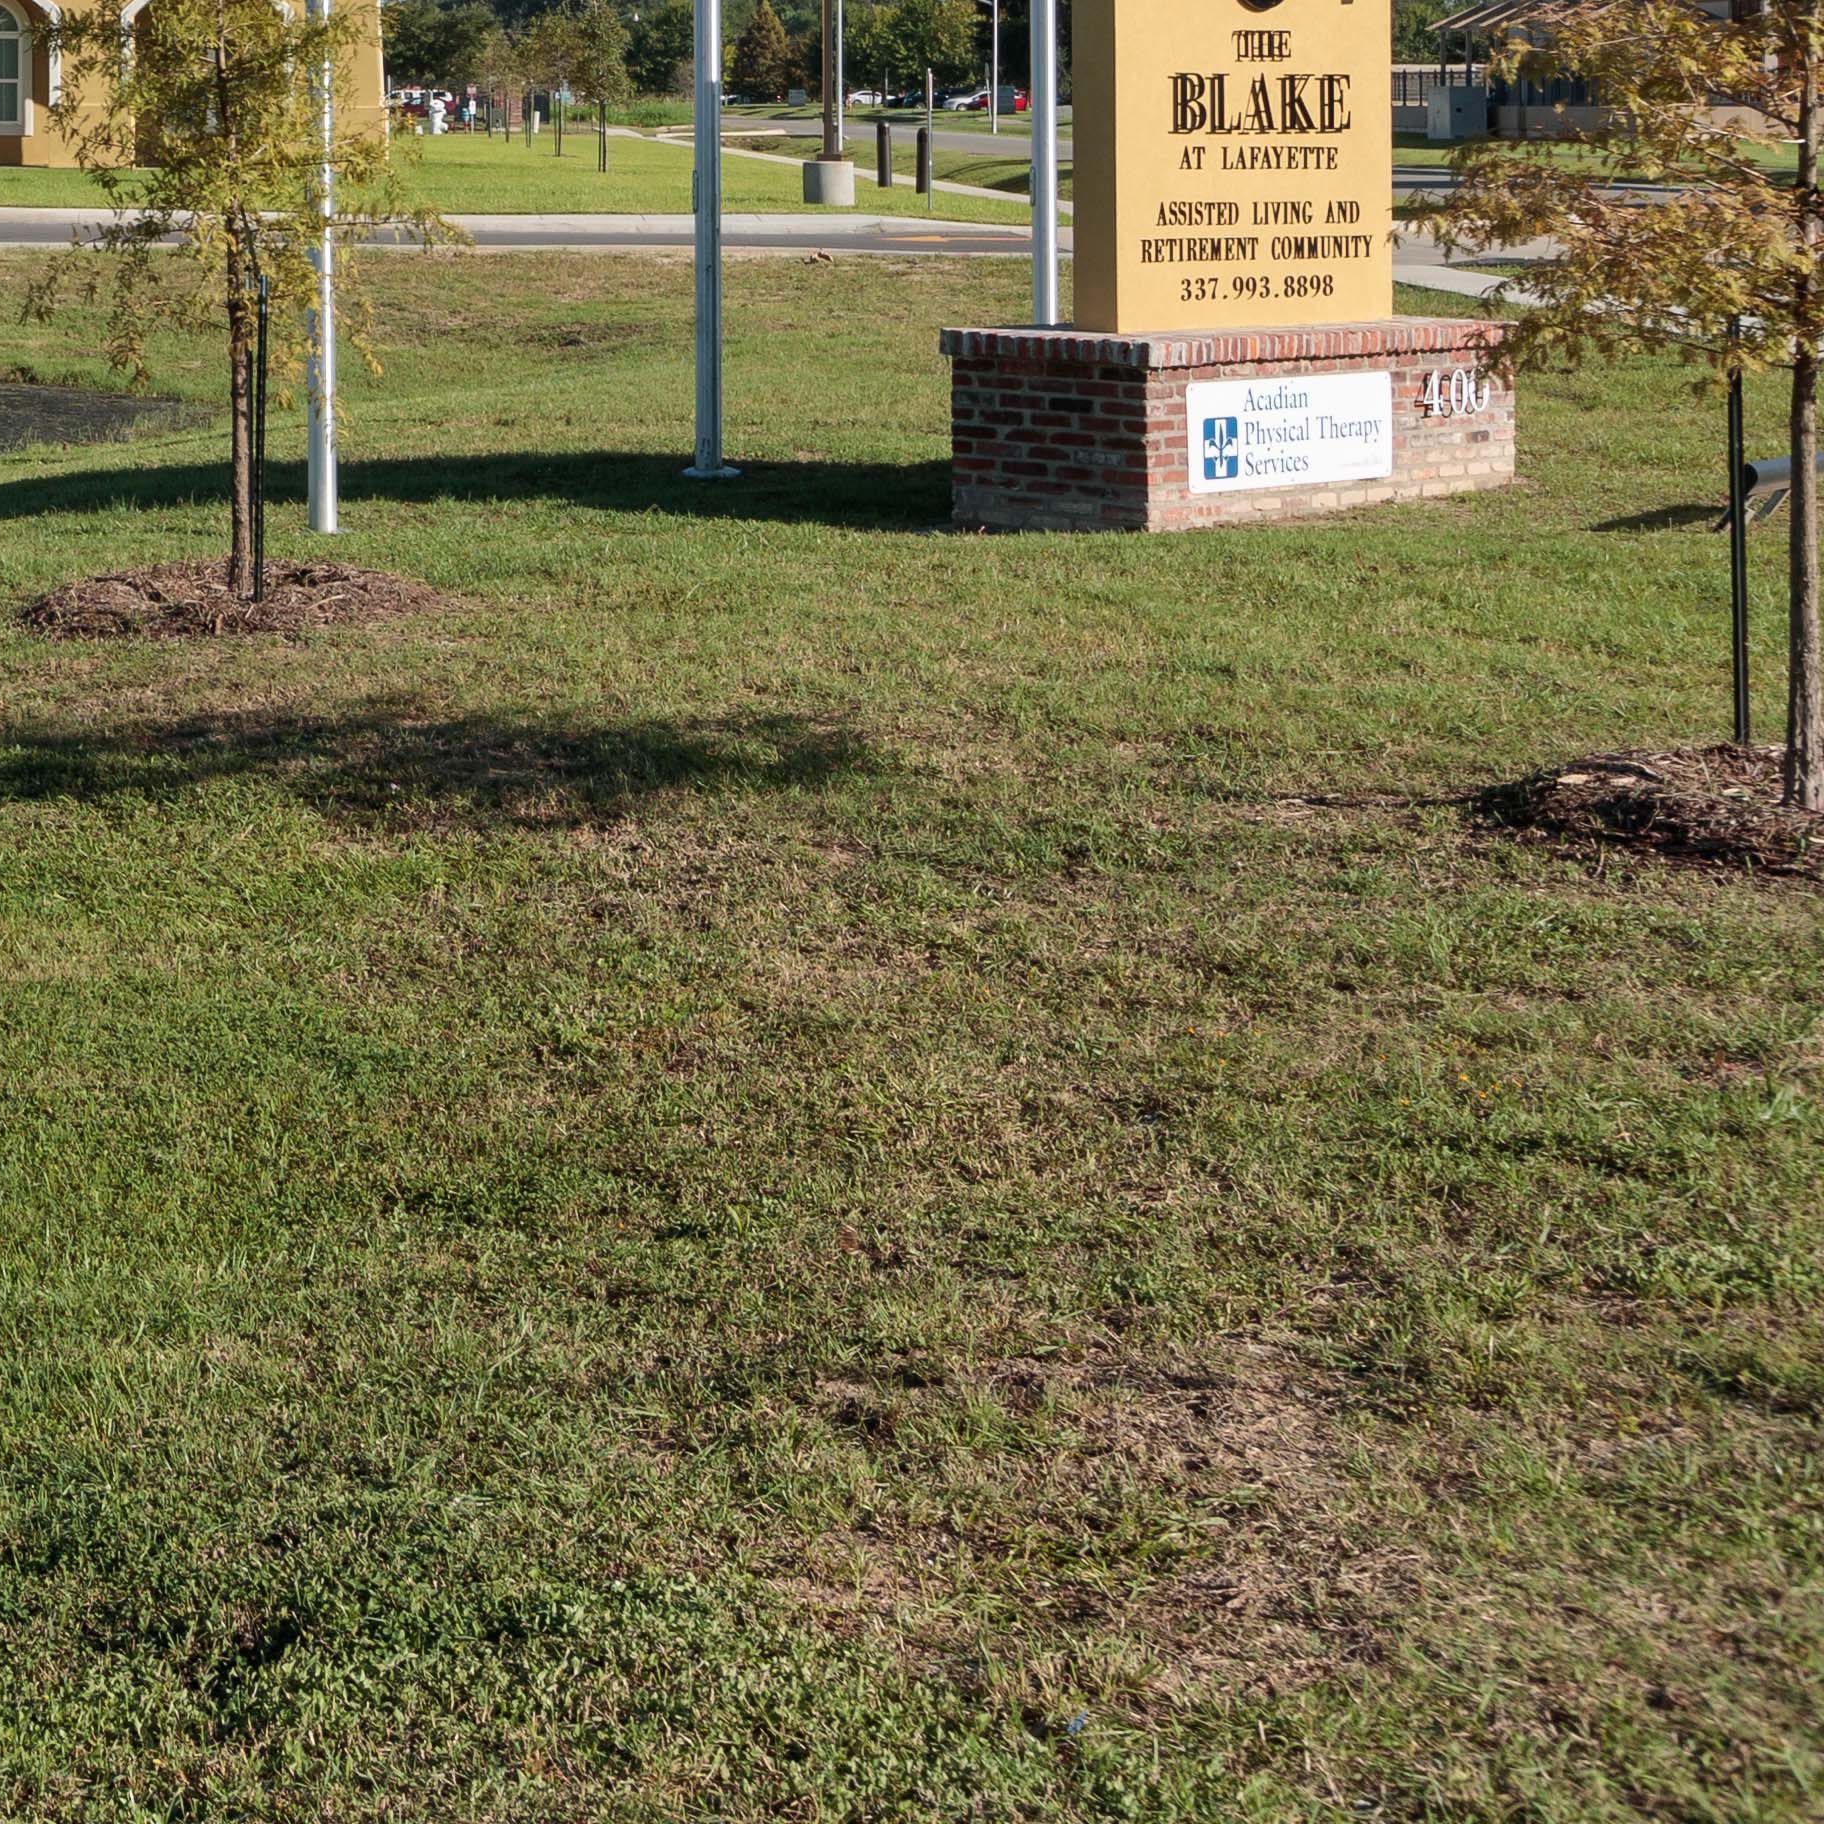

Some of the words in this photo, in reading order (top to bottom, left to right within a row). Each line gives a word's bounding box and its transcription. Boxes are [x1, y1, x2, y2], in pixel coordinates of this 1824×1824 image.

[1232, 30, 1292, 62] THE
[1169, 72, 1351, 133] BLAKE
[1179, 146, 1206, 169] AT
[1221, 146, 1338, 169] LAFAYETTE
[1156, 201, 1239, 226] ASSISTED
[1252, 201, 1313, 224] LIVING
[1325, 200, 1360, 224] AND
[1141, 237, 1259, 263] RETIREMENT
[1271, 235, 1373, 260] COMMUNITY
[1180, 275, 1334, 301] 337.993.8898
[1243, 385, 1309, 412] Acadian
[1423, 368, 1490, 414] 400
[1244, 417, 1310, 452] Physical
[1316, 416, 1382, 443] Therapy
[1244, 449, 1309, 476] Services
